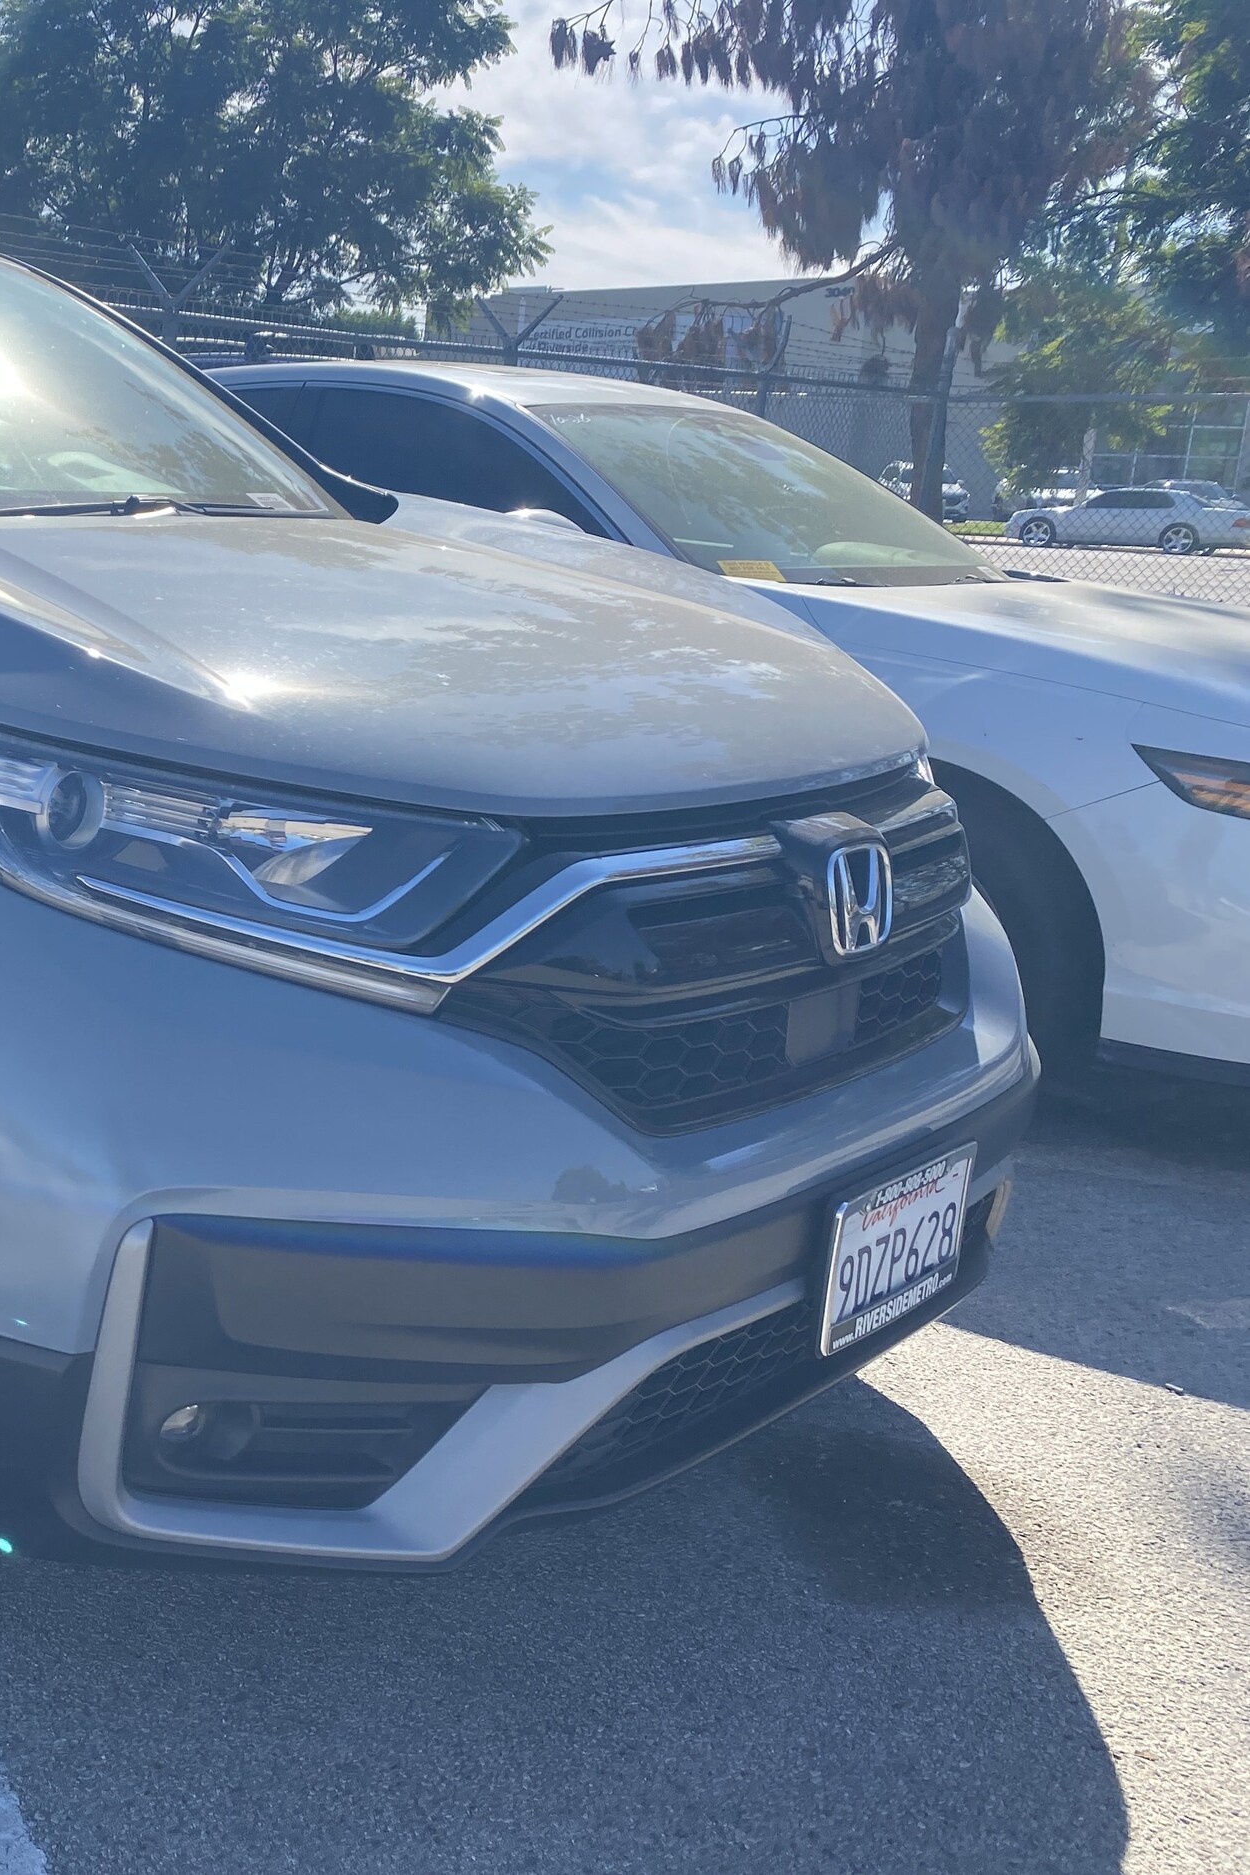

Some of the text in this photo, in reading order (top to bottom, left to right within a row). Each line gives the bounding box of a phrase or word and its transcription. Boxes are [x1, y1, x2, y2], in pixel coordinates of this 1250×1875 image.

[575, 326, 622, 339] Collision
[836, 1202, 957, 1322] 9DZP628
[832, 1272, 953, 1350] www.RIVERSIDEMETRO.com
